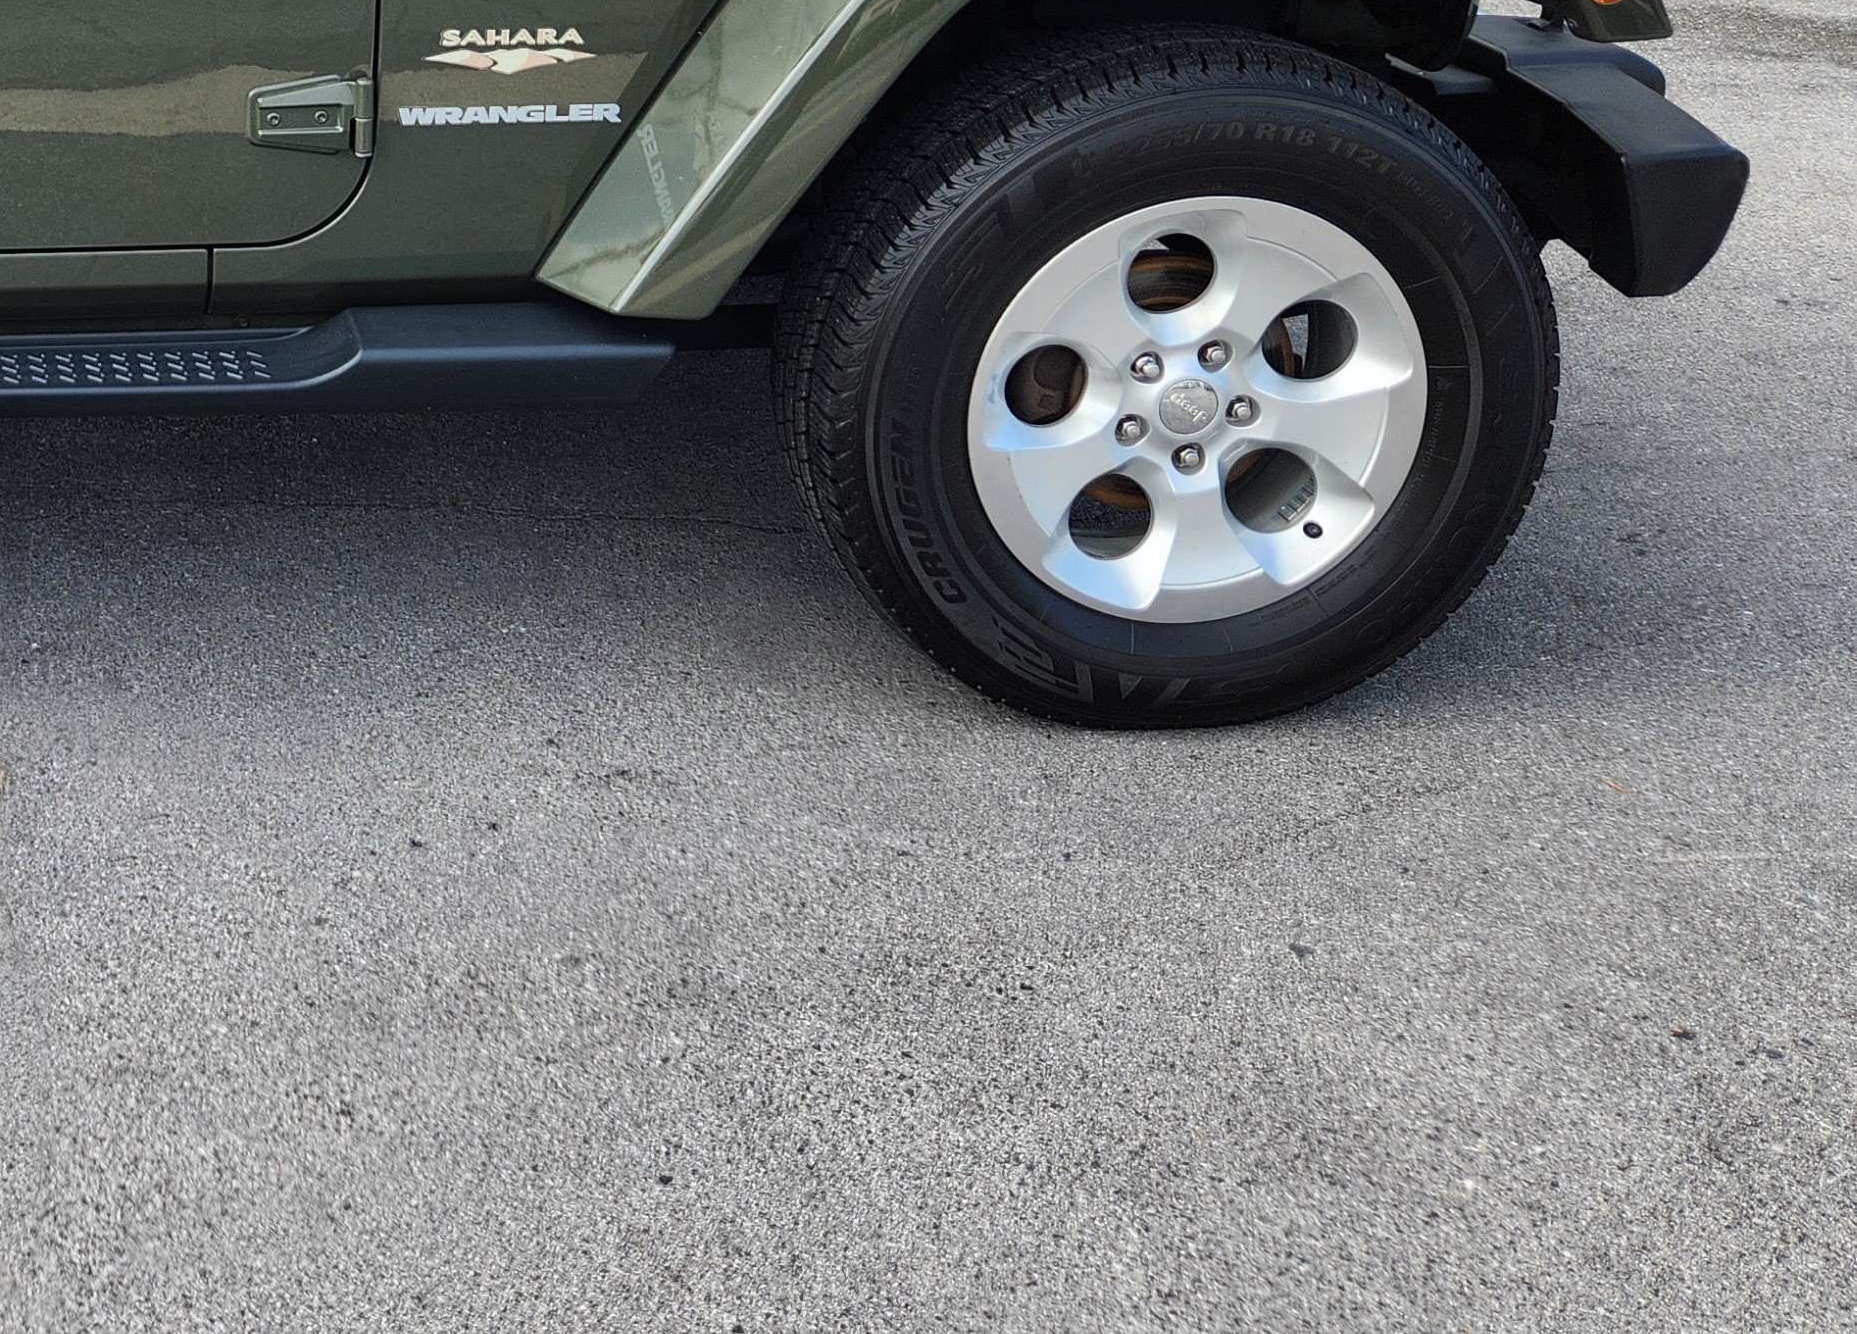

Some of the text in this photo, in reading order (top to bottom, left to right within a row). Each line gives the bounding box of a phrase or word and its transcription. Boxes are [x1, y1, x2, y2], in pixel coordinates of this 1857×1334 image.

[440, 28, 585, 47] SAHARA
[398, 103, 622, 126] WRANGLER
[1254, 122, 1317, 147] R18
